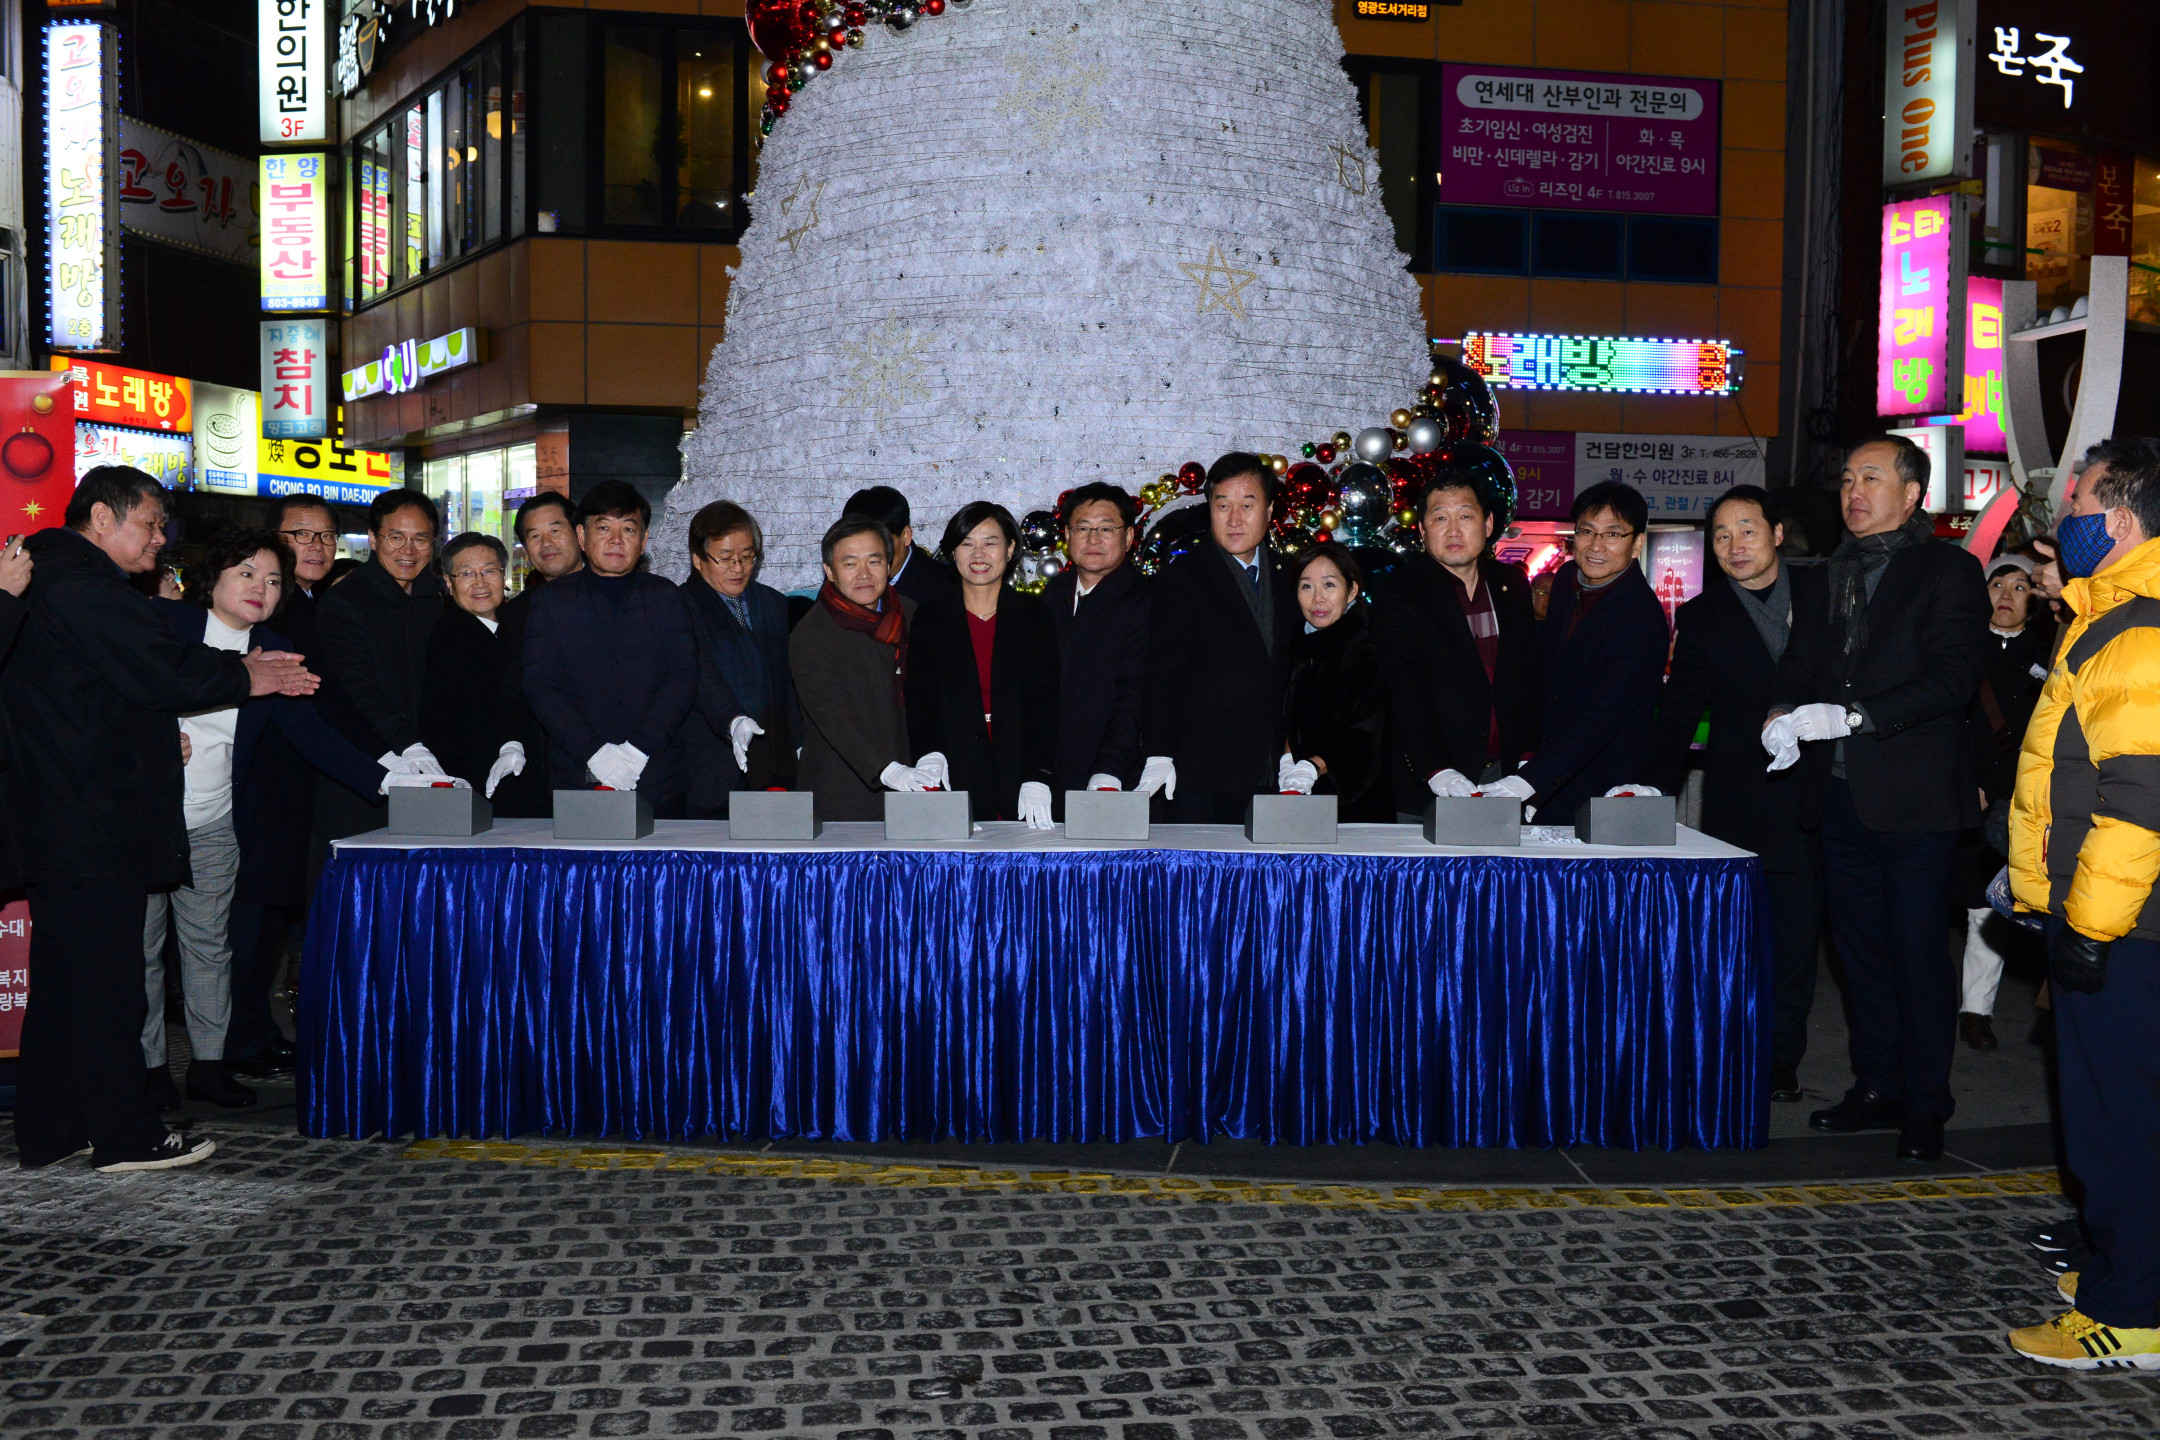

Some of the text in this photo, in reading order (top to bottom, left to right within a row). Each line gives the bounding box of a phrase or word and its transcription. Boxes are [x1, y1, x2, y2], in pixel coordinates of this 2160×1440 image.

[1357, 0, 1428, 18] 영광도서거리점
[276, 0, 310, 112] 한의원
[1988, 26, 2084, 109] 본죽
[1475, 80, 1686, 114] 연세대 산부인과 전문의
[1900, 0, 1938, 173] Plus One
[280, 117, 304, 137] 3F
[1616, 154, 1705, 175] 야간진료 9시
[1539, 182, 1582, 201] 리즈인
[1587, 186, 1603, 199] 4F
[2097, 165, 2132, 243] 본죽
[58, 168, 98, 307] 노래방
[269, 183, 317, 279] 부동산
[1890, 209, 1945, 245] 스타
[68, 318, 92, 337] 2층
[268, 324, 320, 343] 지중해
[1893, 251, 1935, 404] 노래방
[382, 338, 418, 394] CU
[1483, 336, 1617, 389] 노래방
[273, 348, 317, 416] 참치
[95, 370, 173, 418] 노래방
[268, 421, 322, 435] 밍크고래
[1509, 443, 1523, 453] 4F
[1586, 442, 1674, 460] 건담한의원
[1681, 445, 1696, 459] 3F
[1518, 467, 1541, 480] 9시
[1653, 469, 1709, 485] 야간진료
[1713, 470, 1735, 486] 8시
[269, 479, 304, 496] CHONG
[323, 486, 339, 500] BIN
[1526, 489, 1560, 509] 감기
[1664, 496, 1689, 511] 관절
